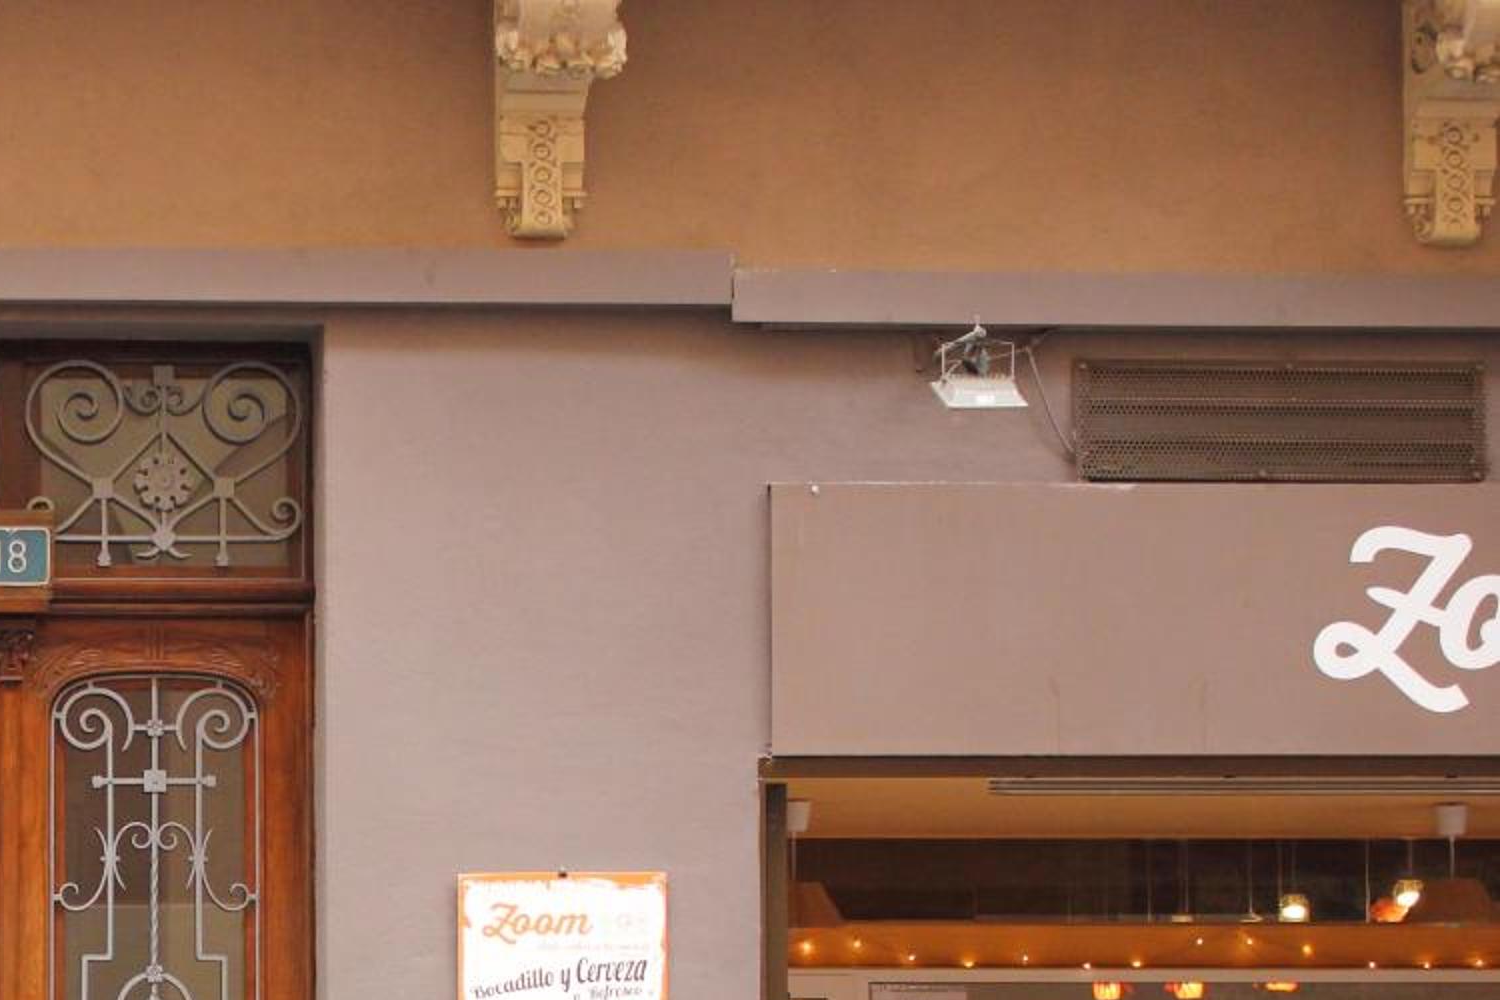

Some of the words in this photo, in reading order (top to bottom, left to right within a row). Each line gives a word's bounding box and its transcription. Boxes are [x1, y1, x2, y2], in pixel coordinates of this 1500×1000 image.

[482, 902, 592, 945] Zoom
[472, 966, 555, 999] Bocadillo
[560, 966, 572, 993] y
[576, 956, 649, 984] Cerveza
